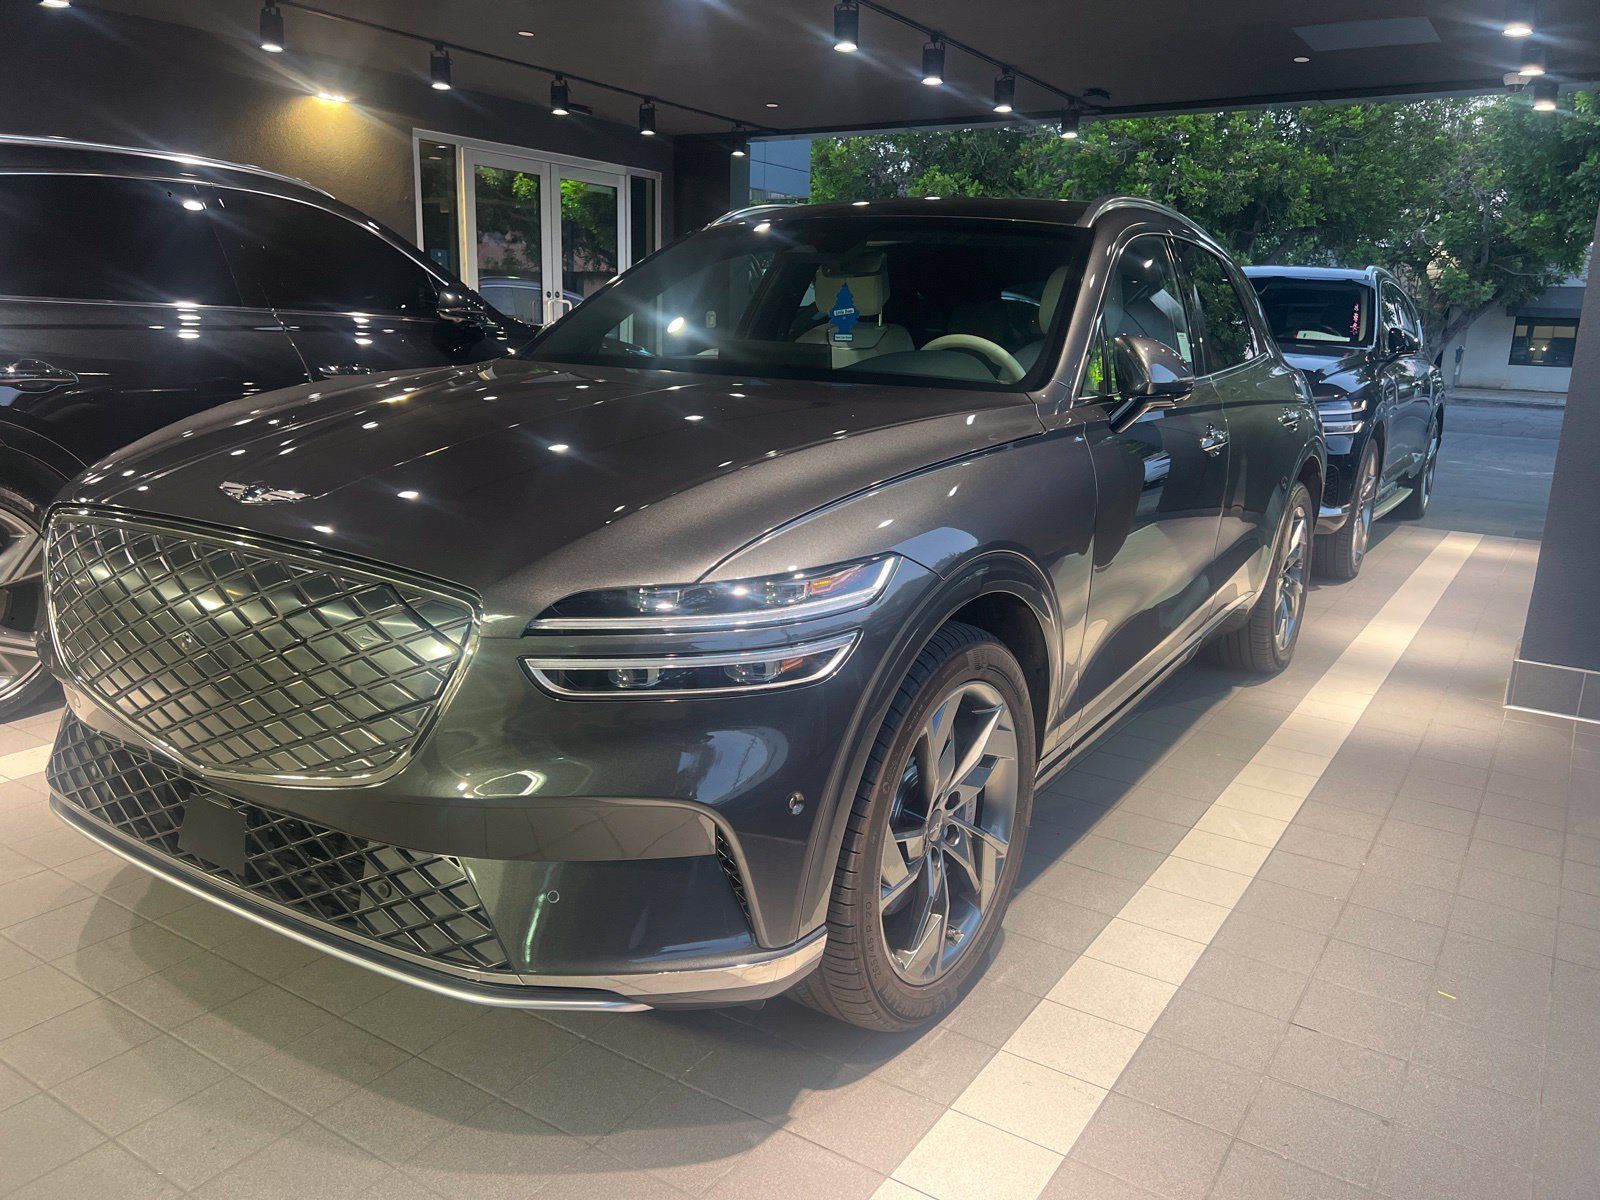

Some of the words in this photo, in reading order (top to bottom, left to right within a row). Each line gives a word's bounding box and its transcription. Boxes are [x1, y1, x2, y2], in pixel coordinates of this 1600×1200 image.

[865, 901, 873, 919] 20
[865, 924, 873, 933] R
[866, 937, 882, 979] 265/45
